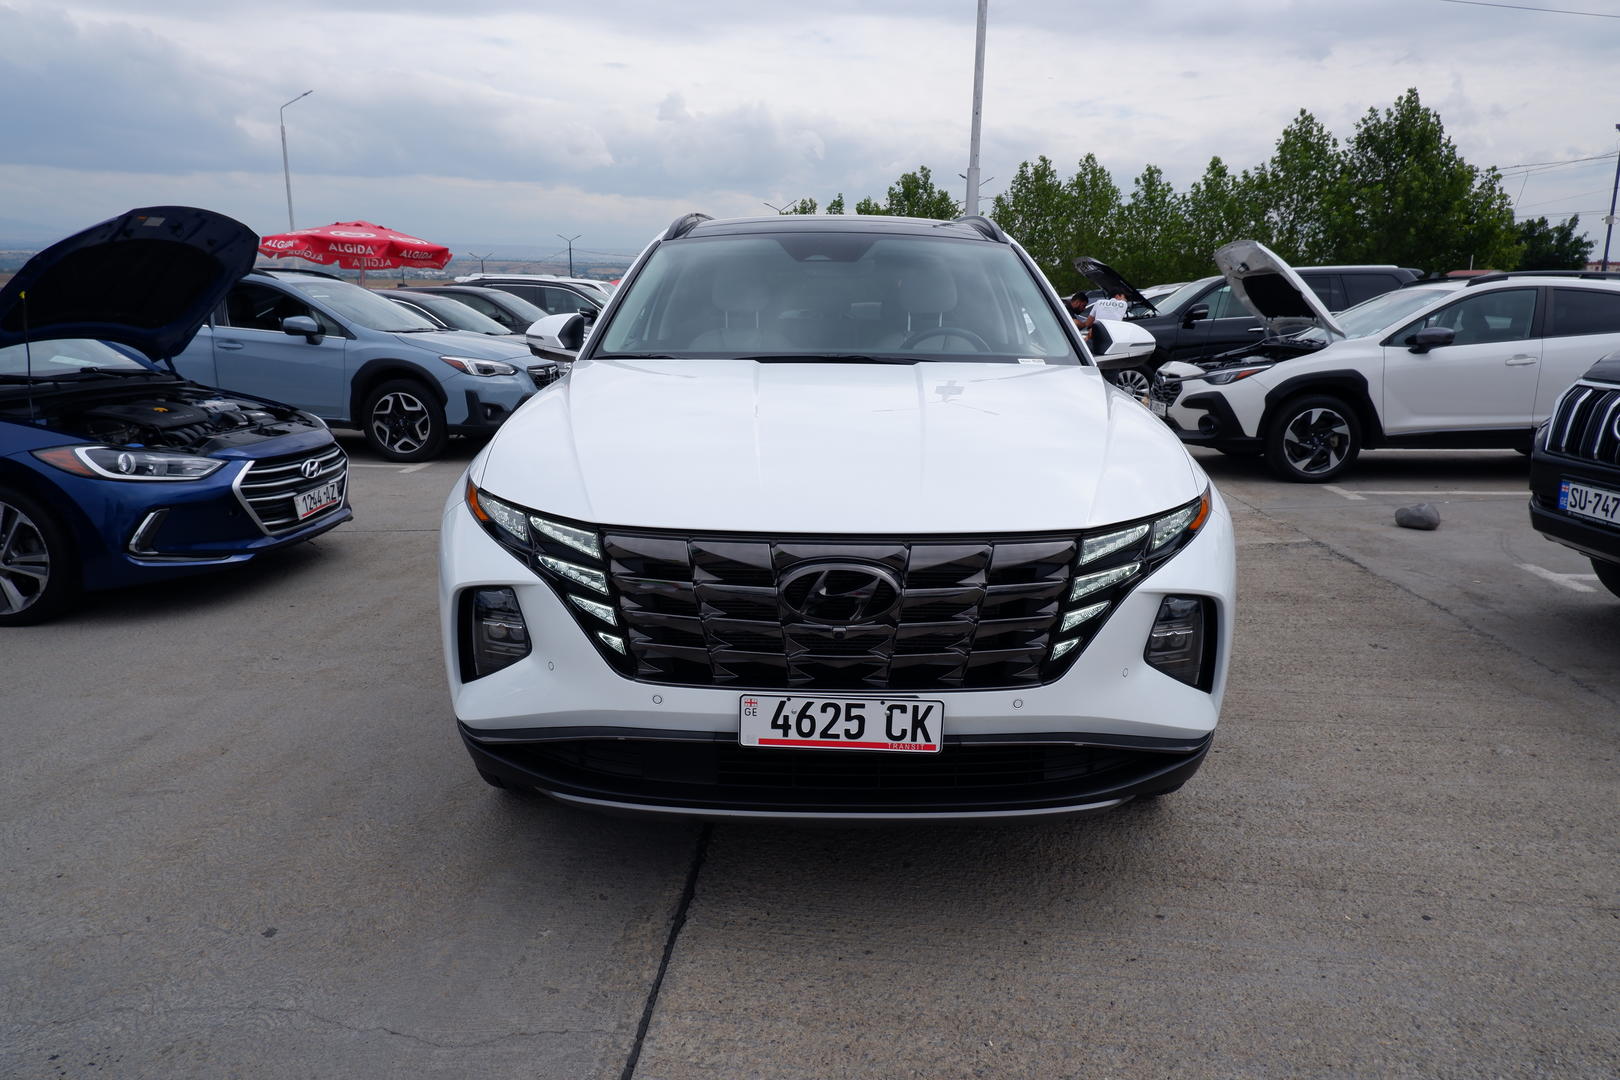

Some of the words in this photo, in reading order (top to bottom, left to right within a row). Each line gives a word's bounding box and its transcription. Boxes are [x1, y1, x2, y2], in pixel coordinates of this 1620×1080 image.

[328, 242, 375, 256] ALGIDA
[744, 707, 758, 717] GE
[770, 700, 867, 741] 4625
[885, 703, 934, 743] CK
[888, 742, 926, 751] TRANSIT
